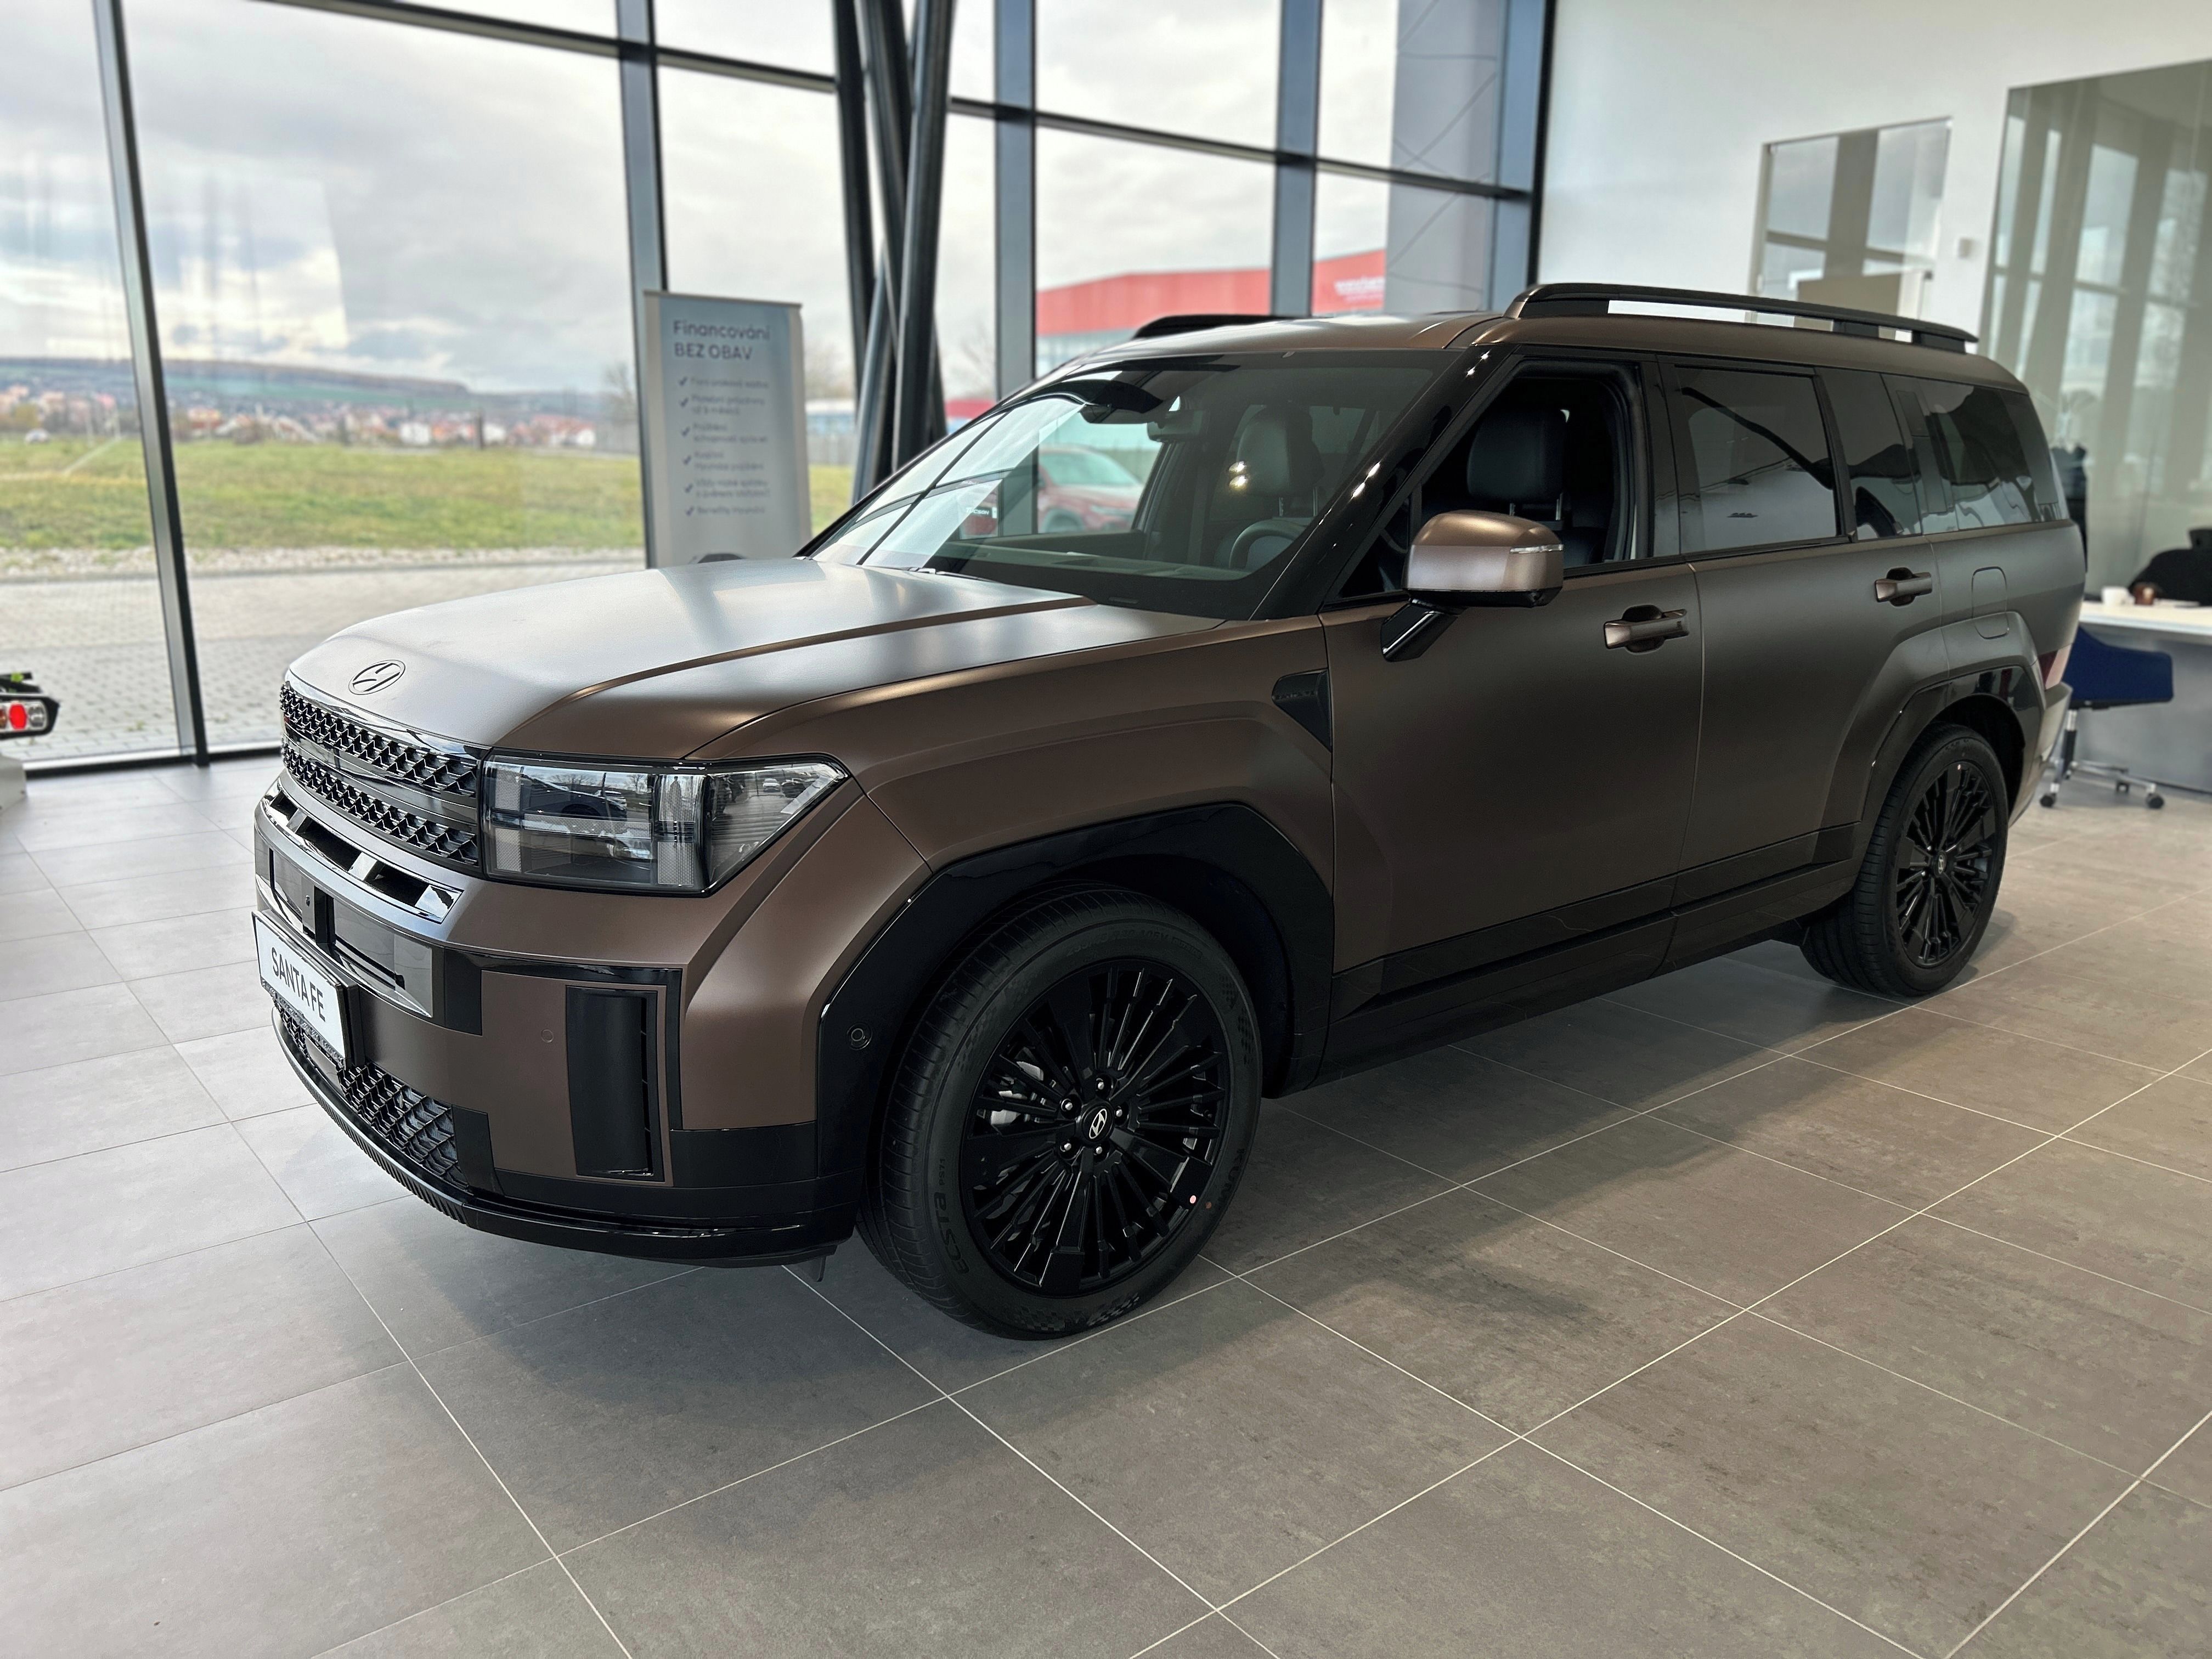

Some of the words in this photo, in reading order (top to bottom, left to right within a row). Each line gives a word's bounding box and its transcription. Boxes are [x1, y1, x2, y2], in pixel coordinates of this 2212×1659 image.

[674, 342, 704, 358] BEZ
[708, 343, 753, 360] OBAV
[272, 947, 311, 1006] SANTA
[309, 981, 326, 1022] FE
